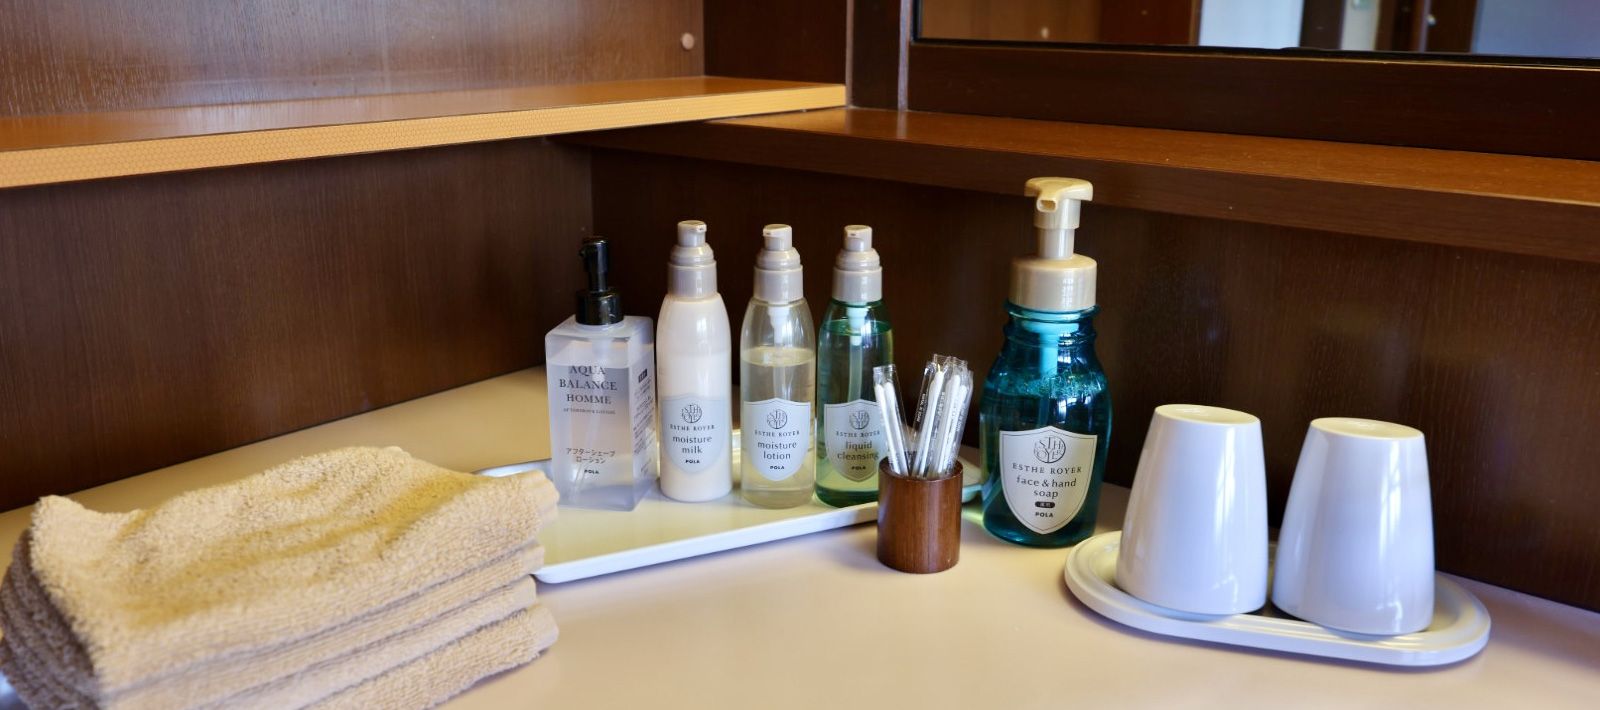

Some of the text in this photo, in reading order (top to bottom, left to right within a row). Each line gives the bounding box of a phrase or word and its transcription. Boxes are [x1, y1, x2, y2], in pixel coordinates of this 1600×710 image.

[569, 365, 606, 376] AQUA
[559, 378, 618, 391] BALANCE
[566, 394, 612, 404] HOMME
[669, 423, 690, 431] ESTHE
[754, 429, 776, 437] ESTHE
[672, 435, 712, 443] moisture
[682, 445, 702, 454] milk
[757, 441, 797, 449] moisture
[845, 441, 873, 451] liquid
[763, 450, 791, 460] lotion
[837, 452, 879, 460] cleansing
[1012, 462, 1082, 475] ESTHE ROYER
[1016, 475, 1077, 488] face & hand
[1033, 489, 1059, 499] soap
